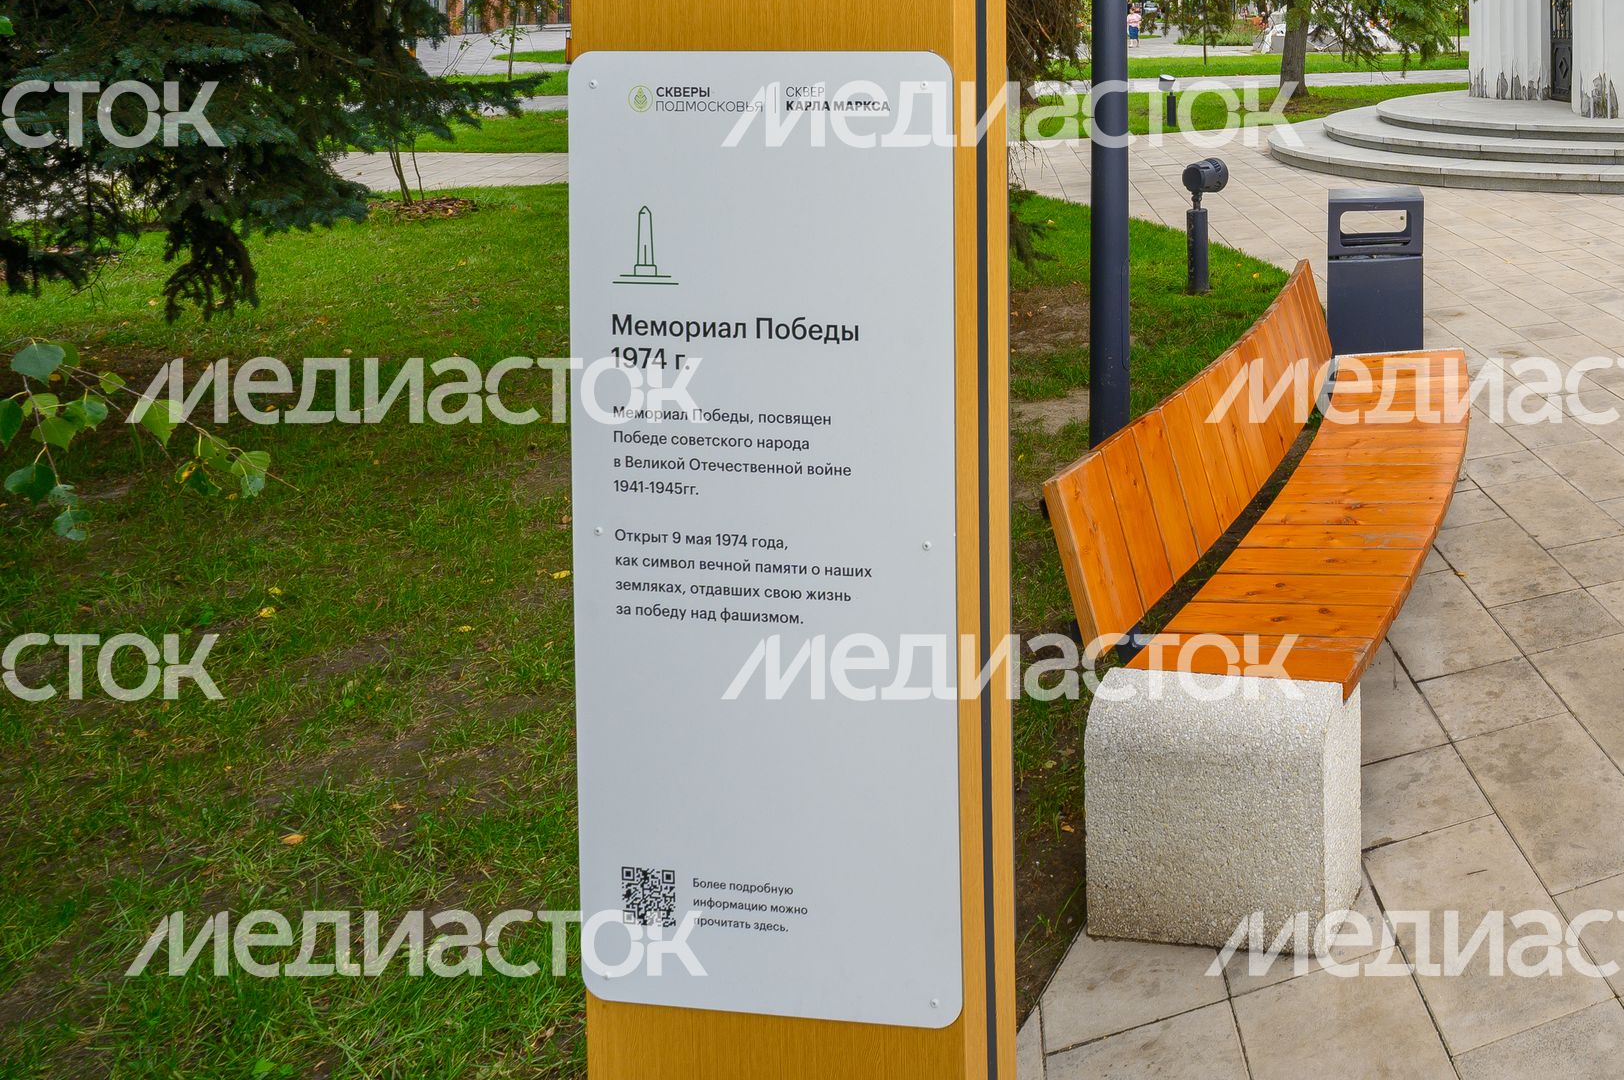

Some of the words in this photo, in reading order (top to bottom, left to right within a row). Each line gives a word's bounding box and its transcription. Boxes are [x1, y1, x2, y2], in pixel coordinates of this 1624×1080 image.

[656, 86, 710, 98] СКВЕРЫ
[656, 101, 763, 112] ПОДМОСКОВЬЯ
[786, 101, 830, 111] КАРЛА
[834, 101, 891, 112] МАРКСА
[612, 314, 747, 342] Мемориал
[755, 317, 860, 344] Победы
[611, 347, 667, 370] 1974
[675, 352, 691, 371] г.
[613, 406, 688, 423] Мемориал
[693, 408, 754, 425] Победы,
[758, 411, 832, 427] посвящен
[613, 431, 667, 447] Победе
[671, 434, 753, 449] советского
[757, 436, 810, 452] народа
[614, 456, 621, 468] в
[625, 455, 685, 471] Великой
[689, 458, 803, 476] Отечественной
[807, 463, 852, 478] войне
[614, 480, 699, 496] 1941-1945гг.
[615, 529, 668, 546] Открыт
[672, 531, 681, 544] 9
[685, 533, 712, 546] мая
[716, 533, 748, 548] 1974
[751, 535, 788, 551] года,
[615, 555, 638, 567] как
[642, 556, 695, 570] символ
[699, 555, 751, 573] вечной
[755, 560, 808, 575] памяти
[811, 563, 820, 576] о
[824, 563, 872, 579] наших
[616, 579, 687, 595] земляках,
[690, 582, 760, 599] отдавших
[764, 586, 802, 600] свою
[806, 588, 852, 604] жизнь
[616, 604, 632, 616] за
[635, 603, 687, 621] победу
[691, 607, 716, 621] над
[720, 608, 804, 626] фашизмом.
[693, 878, 727, 890] Более
[729, 881, 793, 897] подробную
[693, 898, 768, 914] информацию
[770, 904, 808, 916] можно
[694, 916, 751, 931] прочитать
[753, 921, 789, 933] здесь.
